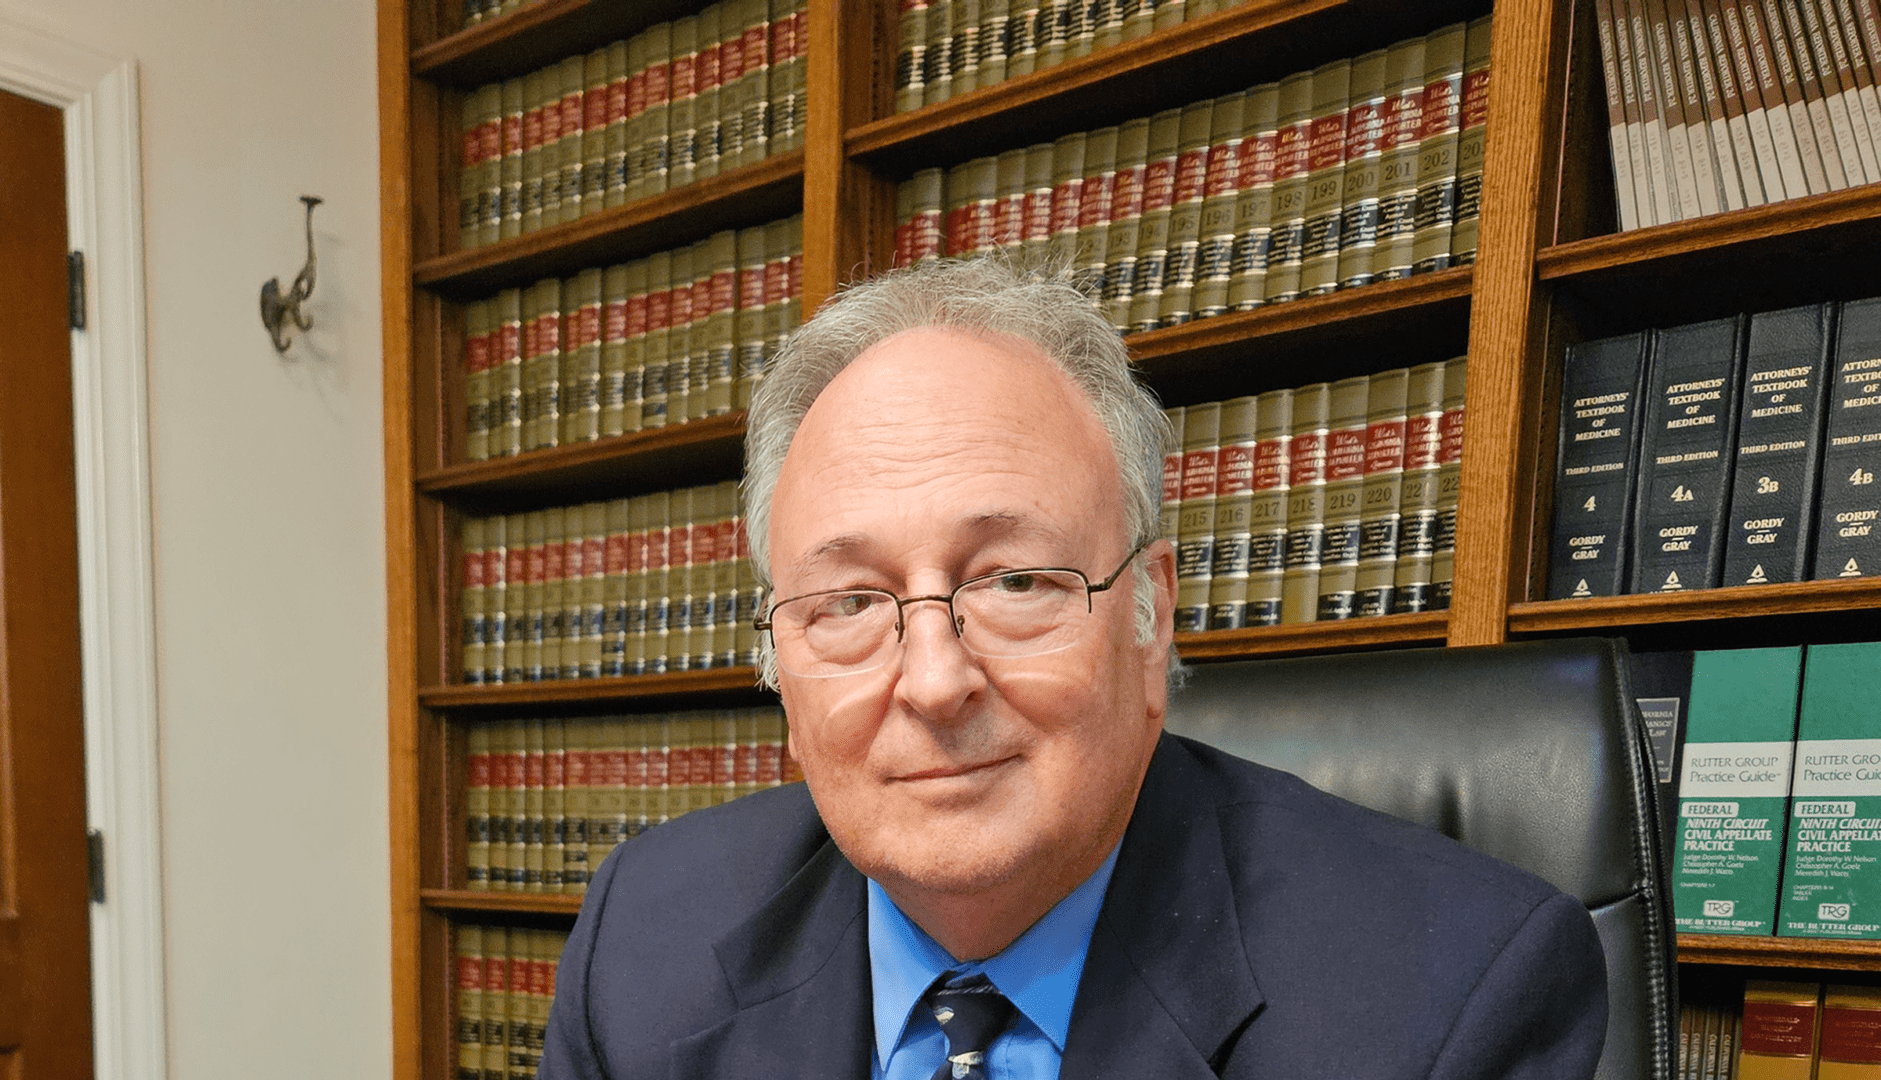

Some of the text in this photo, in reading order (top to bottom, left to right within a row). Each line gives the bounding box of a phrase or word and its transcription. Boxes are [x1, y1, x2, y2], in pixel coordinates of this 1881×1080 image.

[1829, 24, 1846, 62] REPORTER
[1846, 22, 1862, 59] REPORTER
[1866, 18, 1881, 55] REPORTER
[1796, 36, 1812, 72] REPORTER
[1812, 30, 1829, 69] REPORTER
[1737, 46, 1752, 84] REPORTER
[1755, 44, 1771, 80] REPORTER
[1776, 39, 1792, 76] REPORTER
[1605, 61, 1617, 97] REPORTER
[1622, 60, 1634, 95] REPORTER
[1639, 58, 1651, 93] REPORTER
[1683, 60, 1695, 97] REPORTER
[1699, 56, 1714, 94] REPORTER
[1718, 54, 1732, 91] REPORTER
[1662, 62, 1674, 99] REPORTER
[1424, 150, 1450, 171] 202
[1385, 162, 1411, 181] 201
[1349, 171, 1375, 191] 200
[1312, 180, 1337, 201] 199
[1278, 190, 1303, 211] 198
[1752, 378, 1808, 394] TEXTBOOK
[1863, 384, 1880, 393] OF
[1668, 391, 1721, 406] TEXTBOOK
[1771, 394, 1787, 403] OF
[1576, 404, 1625, 419] TEXTBOOK
[1686, 406, 1701, 415] OF
[1752, 404, 1803, 418] MEDICINE
[1592, 418, 1606, 428] OF
[1666, 415, 1716, 429] MEDICINE
[1575, 428, 1621, 441] MEDICINE
[1832, 436, 1861, 446] THIRD
[1740, 440, 1806, 455] THIRD EDITION
[1656, 450, 1719, 465] THIRD EDITION
[1566, 462, 1624, 475] THIRD EDITION
[1849, 468, 1874, 486] 4B
[1758, 476, 1779, 494] 3B
[1330, 493, 1356, 509] 219
[1367, 487, 1392, 504] 220
[1671, 485, 1694, 502] 4A
[1256, 502, 1280, 518] 217
[1583, 496, 1596, 512] 4
[1184, 512, 1207, 527] 215
[1220, 508, 1244, 524] 216
[1836, 510, 1880, 523] GORDY
[1744, 518, 1785, 530] GORDY
[1659, 526, 1699, 538] GORDY
[1746, 533, 1778, 545] GRAY
[1839, 526, 1872, 538] GRAY
[1569, 535, 1606, 547] GORDY
[1662, 541, 1692, 552] GRAY
[1572, 550, 1600, 560] GRAY
[1691, 756, 1779, 768] RUTTER GROUP
[1805, 755, 1849, 766] RUTTER
[1690, 770, 1735, 782] Practice
[1804, 769, 1852, 781] Practice
[1688, 804, 1733, 815] FEDERAL
[1802, 804, 1850, 815] FEDERAL
[1686, 818, 1770, 829] NINTH CIRCUIT
[1799, 818, 1838, 829] NINTH
[1684, 830, 1773, 840] CIVIL APPELLATE
[1798, 830, 1828, 841] CIVIL
[1684, 841, 1735, 851] PRACTICE
[1796, 842, 1852, 852] PRACTICE
[1706, 902, 1732, 915] TRG
[1822, 906, 1848, 918] TRG
